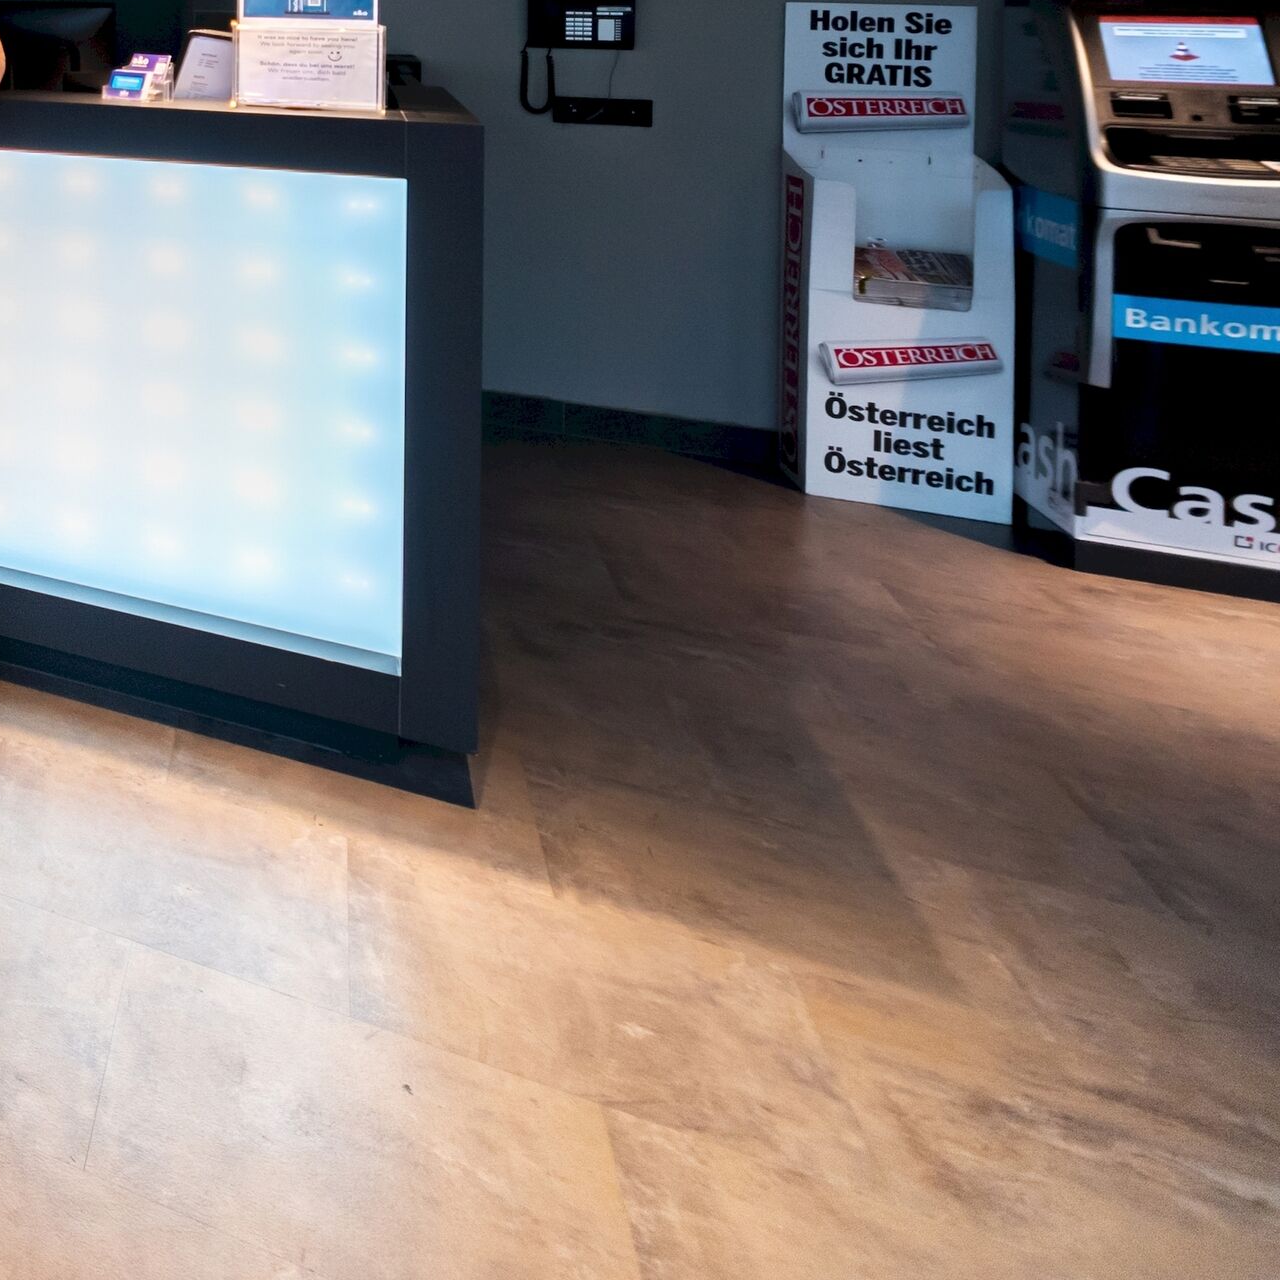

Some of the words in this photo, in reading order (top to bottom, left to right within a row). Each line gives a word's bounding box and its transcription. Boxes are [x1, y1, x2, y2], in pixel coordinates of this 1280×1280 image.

[810, 9, 895, 32] Holen
[905, 12, 952, 34] Sie
[822, 37, 884, 59] sich
[894, 38, 938, 61] Ihr
[825, 62, 932, 87] GRATIS
[809, 98, 964, 116] ÖSTERREICH
[1125, 308, 1280, 341] Bankom
[838, 342, 996, 368] ÖSTERREICH
[825, 391, 995, 439] Österreich
[873, 430, 944, 460] liest
[824, 446, 994, 496] Österreich
[1111, 467, 1276, 533] Cas
